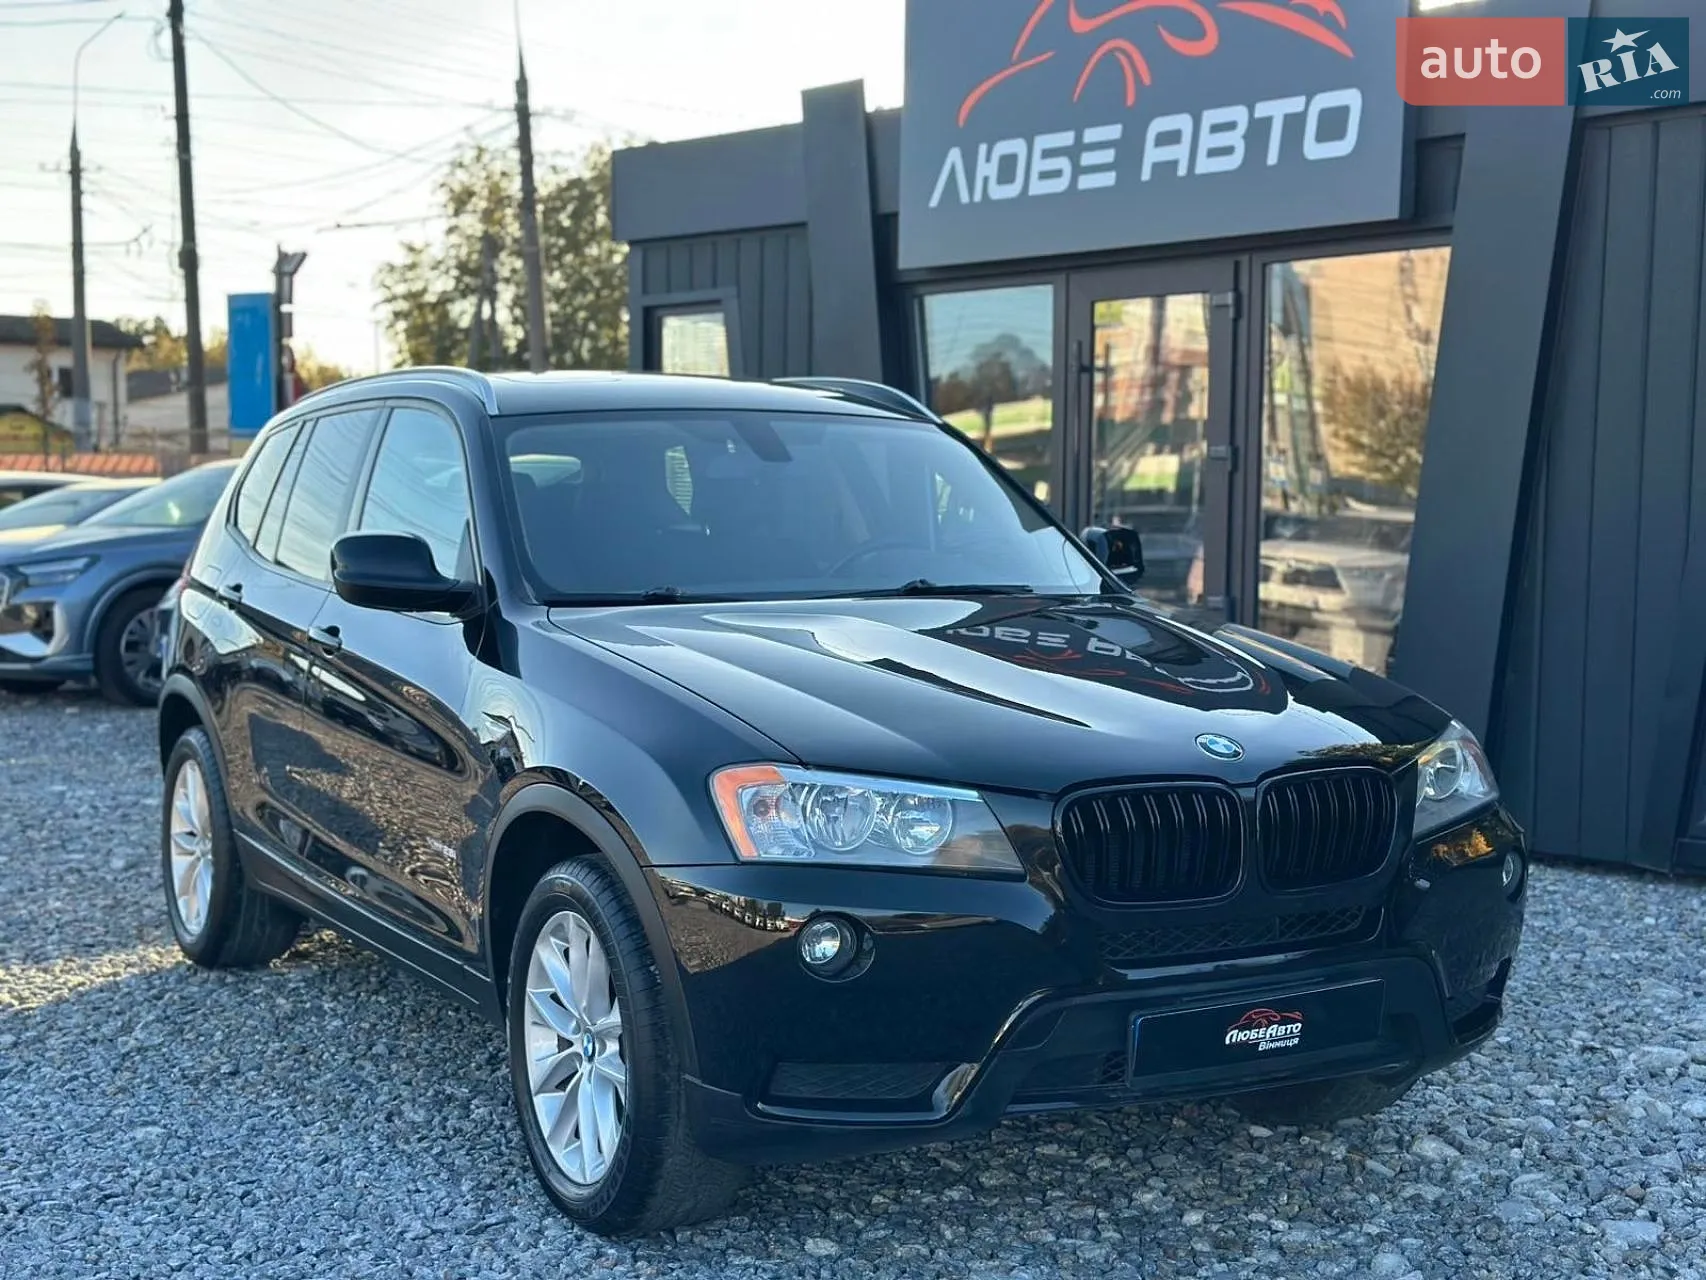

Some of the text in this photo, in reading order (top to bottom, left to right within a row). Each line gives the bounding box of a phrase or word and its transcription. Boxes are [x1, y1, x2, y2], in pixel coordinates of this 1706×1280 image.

[928, 87, 1363, 208] ЛЮБЕ АВТО
[1258, 1037, 1300, 1051] Вінниця
